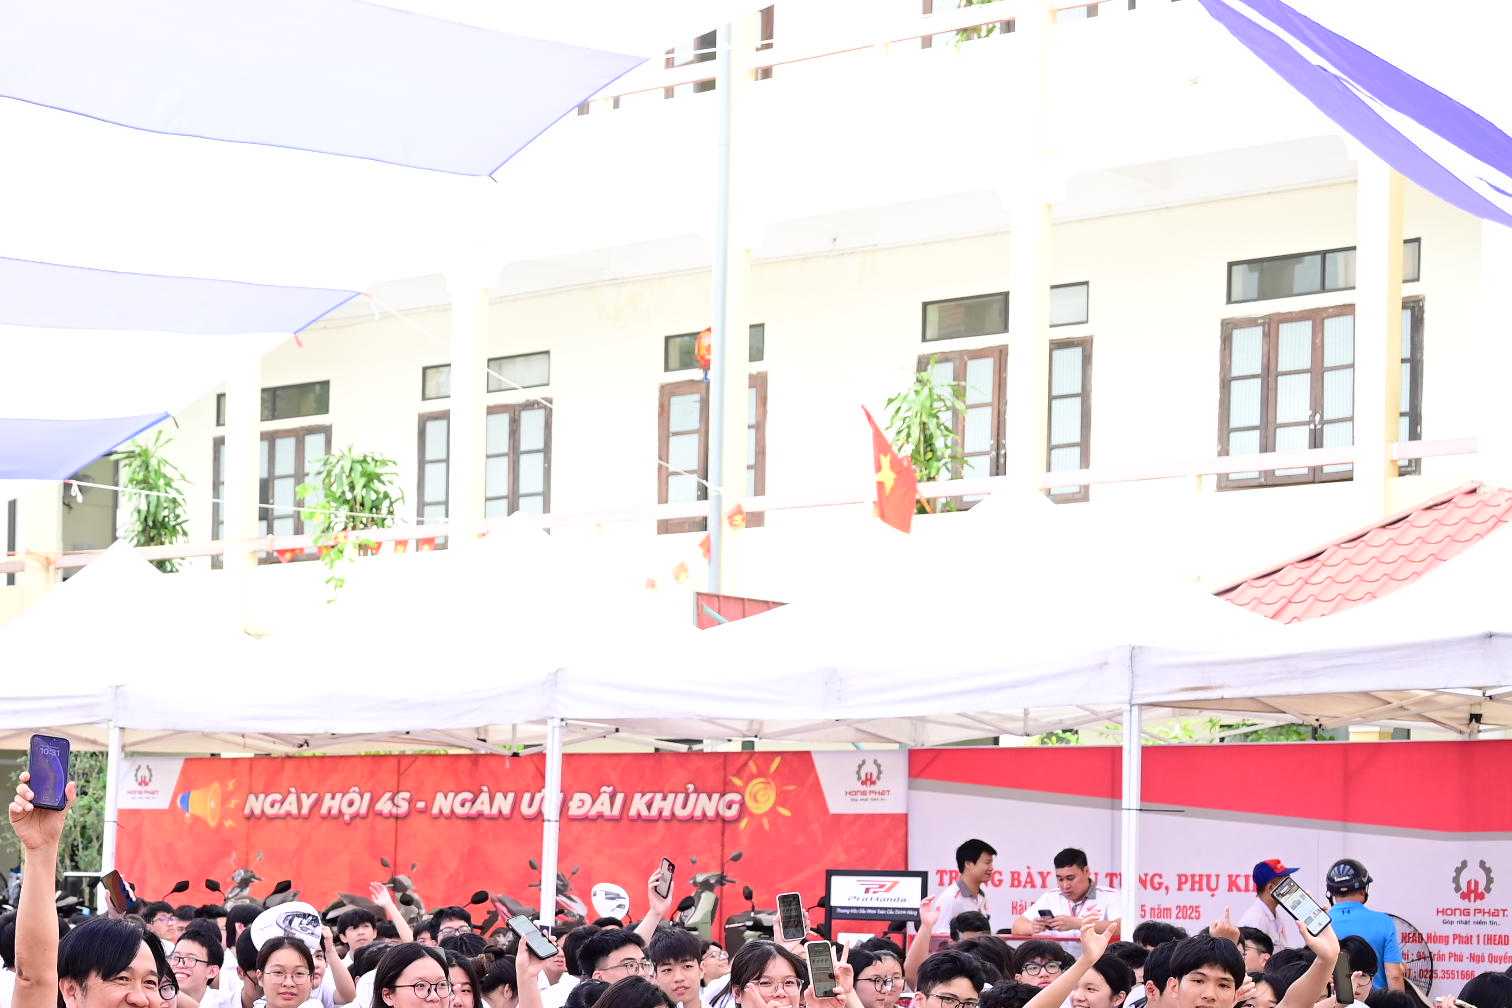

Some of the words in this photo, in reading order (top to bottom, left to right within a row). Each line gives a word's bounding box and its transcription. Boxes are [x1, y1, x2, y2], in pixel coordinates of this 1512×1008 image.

[40, 747, 60, 757] 10:31
[244, 787, 318, 818] NGÀY
[320, 787, 371, 823] HỘI
[374, 791, 411, 818] 4S
[431, 786, 515, 818] NGÀN
[568, 786, 626, 820] ĐÃI
[629, 784, 742, 821] KHỦNG
[1010, 866, 1051, 889] BÀY
[1176, 873, 1220, 898] PHỤ
[1140, 904, 1146, 918] 5
[1150, 905, 1172, 919] năm
[1176, 905, 1201, 920] 2025
[1400, 932, 1424, 944] HEAD
[1427, 931, 1449, 945] Hồng
